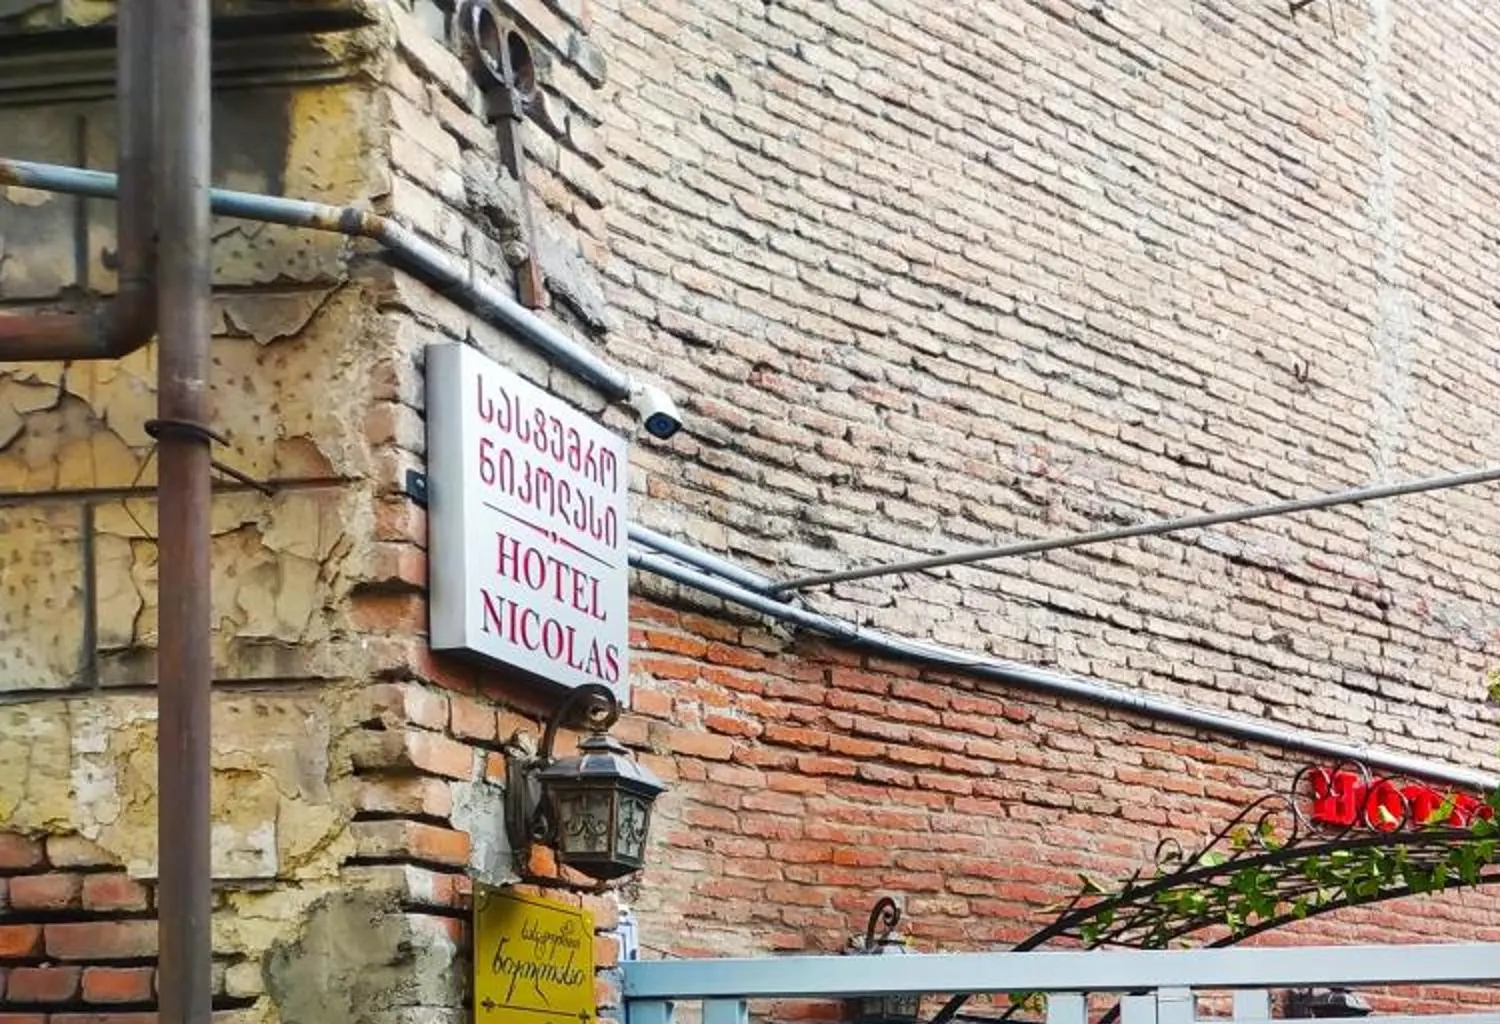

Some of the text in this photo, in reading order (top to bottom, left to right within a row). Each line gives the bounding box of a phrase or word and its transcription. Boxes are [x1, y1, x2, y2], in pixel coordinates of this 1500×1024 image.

[477, 373, 617, 493] სასტუმრო
[479, 437, 617, 549] ნიკოლასი
[496, 531, 607, 621] HOTEL
[480, 588, 620, 684] NICOLAS
